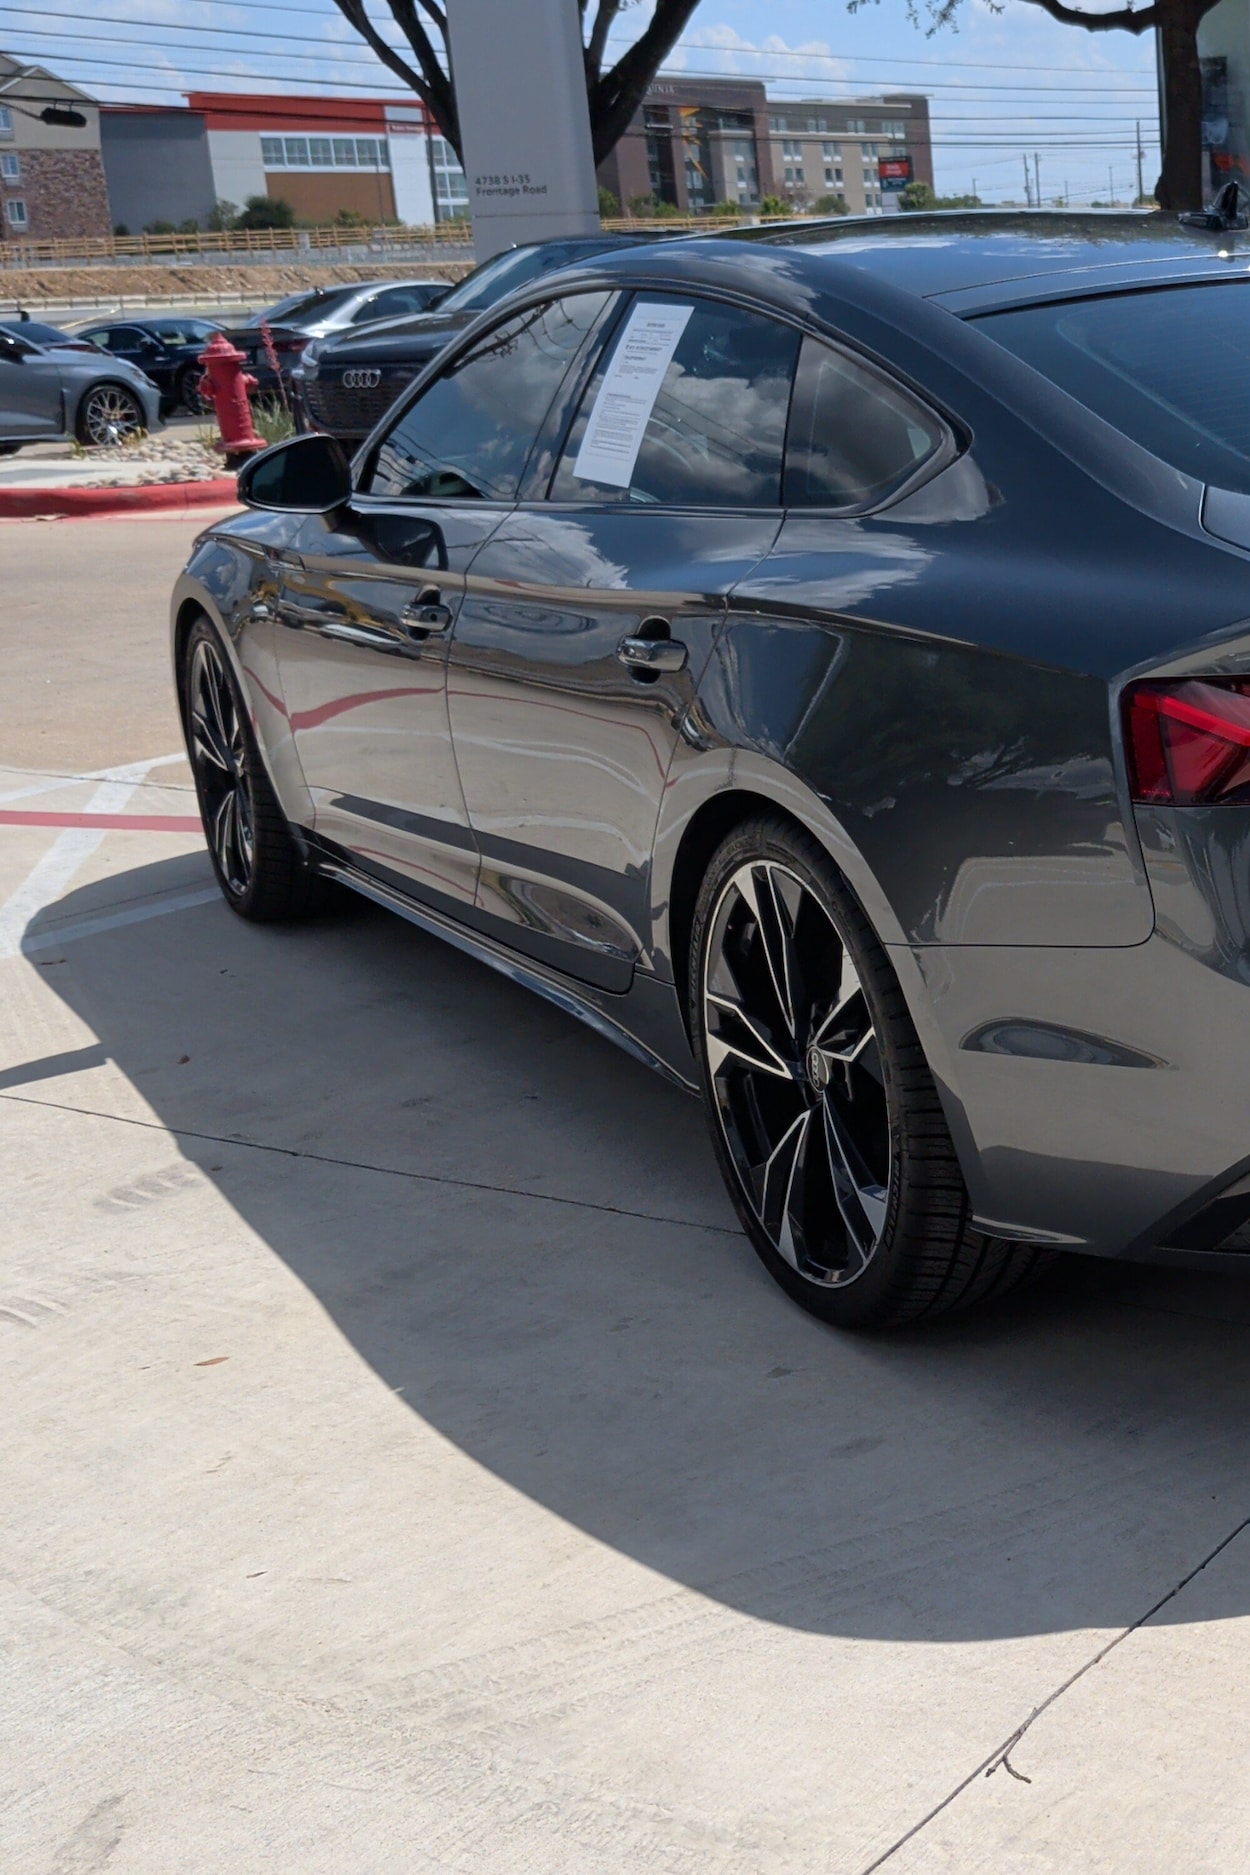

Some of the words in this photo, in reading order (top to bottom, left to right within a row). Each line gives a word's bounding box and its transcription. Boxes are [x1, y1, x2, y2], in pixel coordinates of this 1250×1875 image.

[475, 175, 501, 186] 4738
[503, 174, 510, 185] S
[475, 186, 520, 197] Frontage
[522, 185, 548, 195] Road
